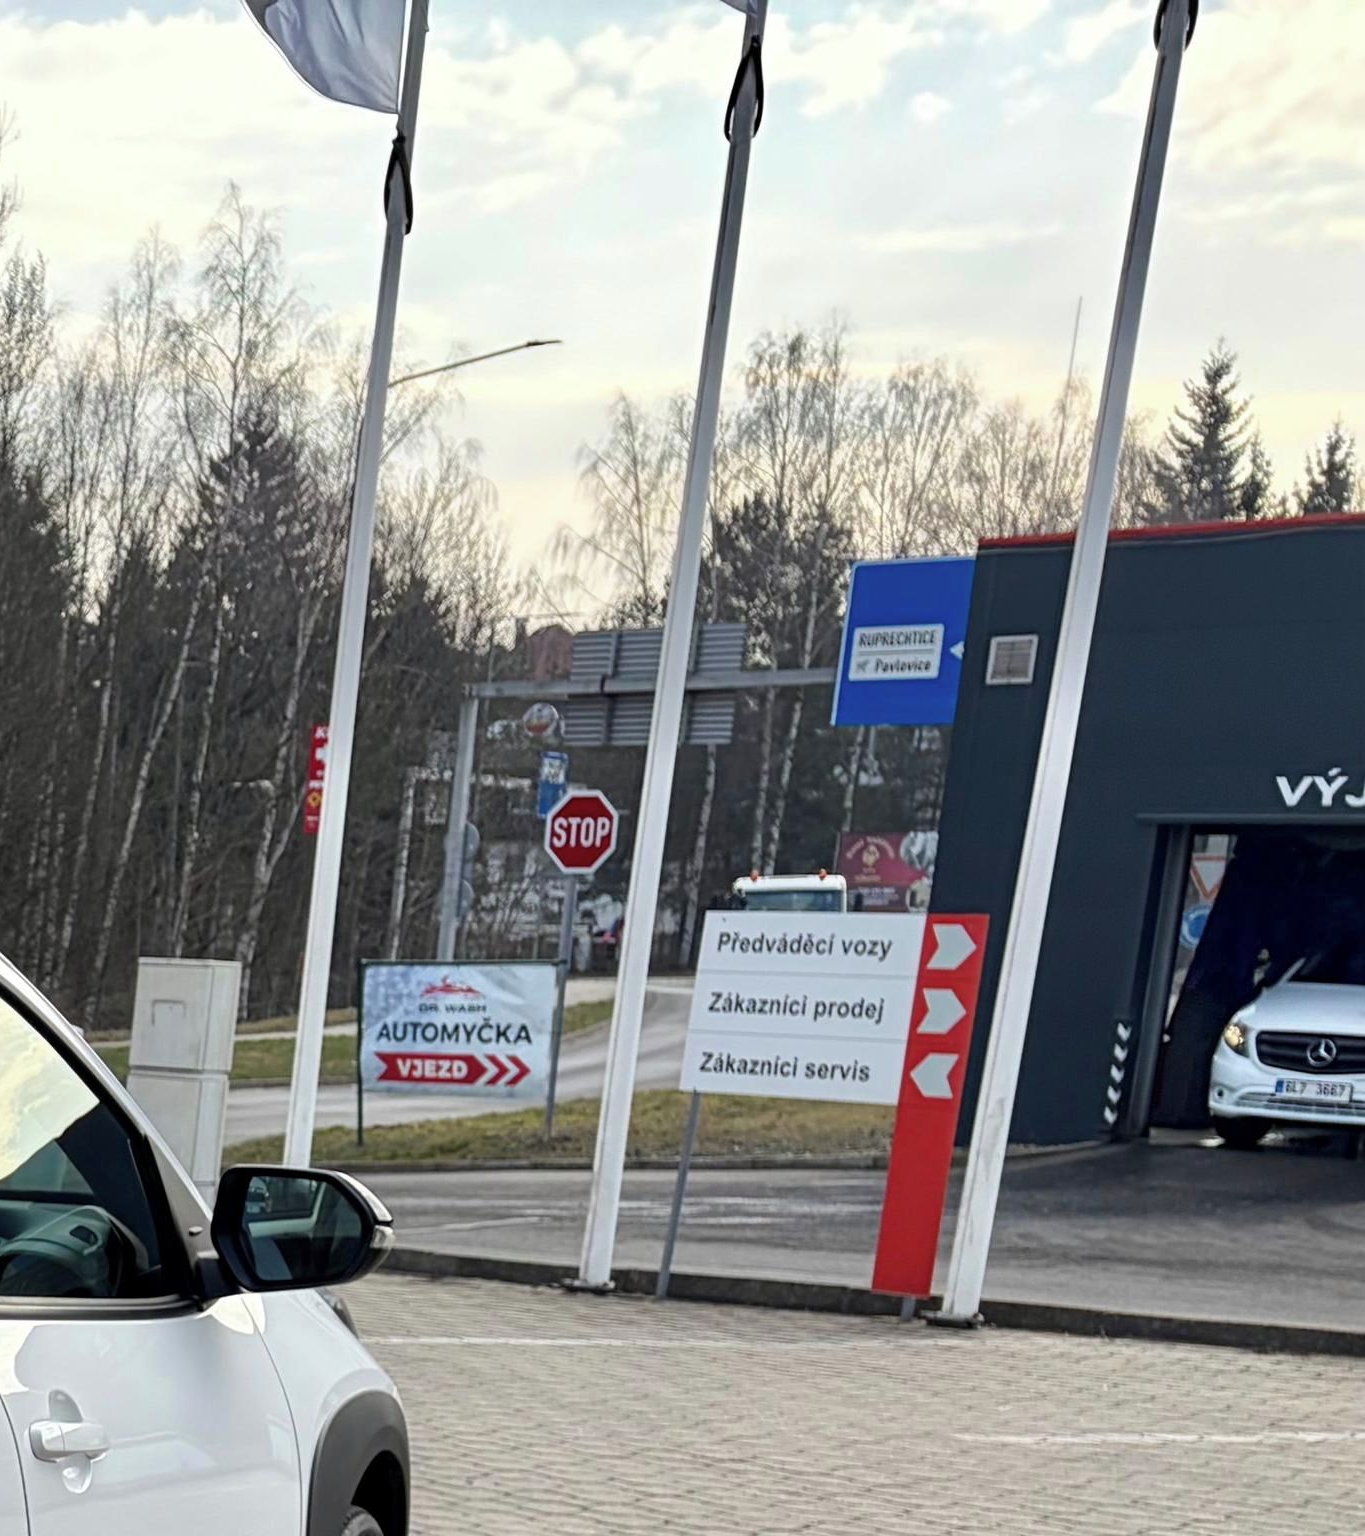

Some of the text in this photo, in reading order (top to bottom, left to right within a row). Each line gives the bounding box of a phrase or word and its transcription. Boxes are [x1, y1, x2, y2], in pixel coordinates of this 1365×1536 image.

[552, 816, 611, 849] STOP
[717, 931, 893, 962] Předváděcí vozy
[708, 991, 885, 1025] Zákazníci prodej
[376, 1016, 532, 1045] AUTOMYČKA
[396, 1057, 469, 1080] VJEZD
[699, 1051, 871, 1083] Zákazníci servis
